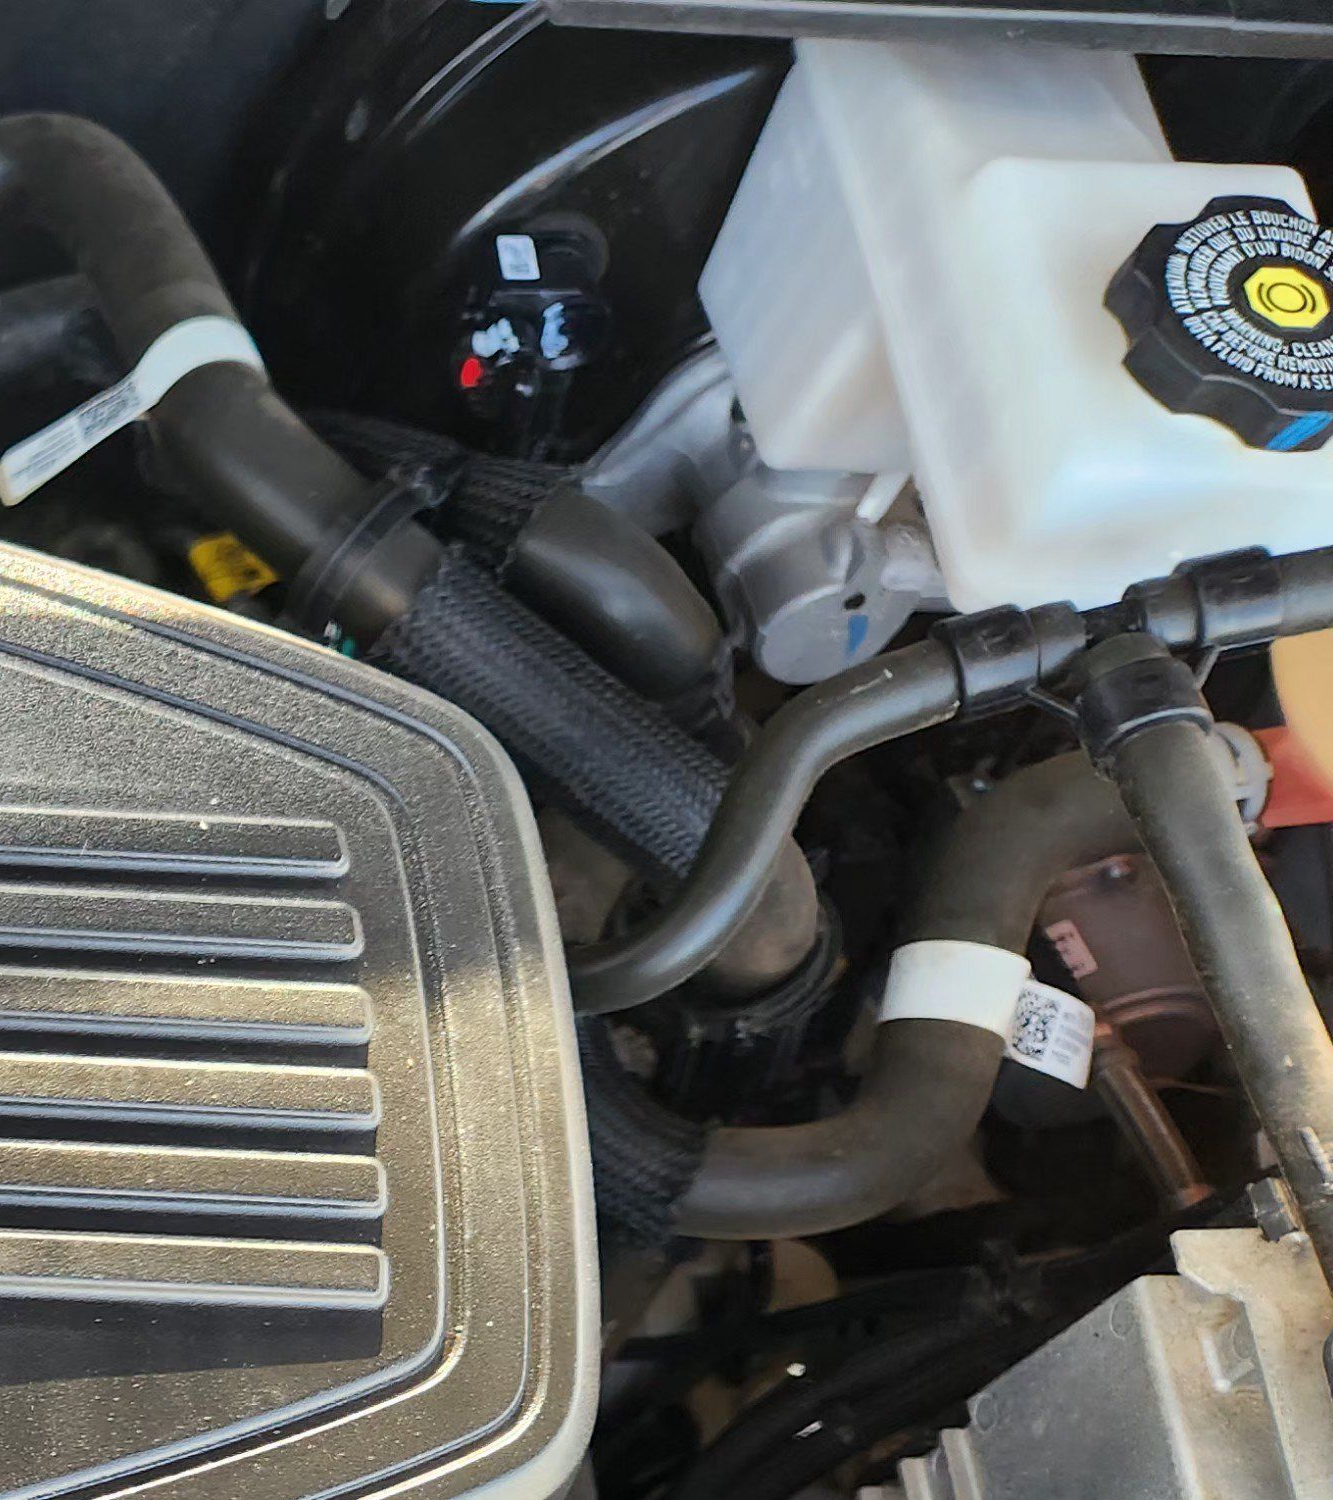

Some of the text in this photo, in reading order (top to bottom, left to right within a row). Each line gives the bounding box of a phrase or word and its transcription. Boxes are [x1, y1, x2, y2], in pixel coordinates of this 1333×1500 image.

[1227, 209, 1250, 227] LE
[1250, 210, 1320, 237] BOUCHON
[1207, 231, 1237, 251] QUE
[1233, 226, 1256, 242] DU
[1257, 227, 1312, 248] LIQUIDE
[1280, 243, 1327, 270] BIDON
[1253, 363, 1299, 389] FROM
